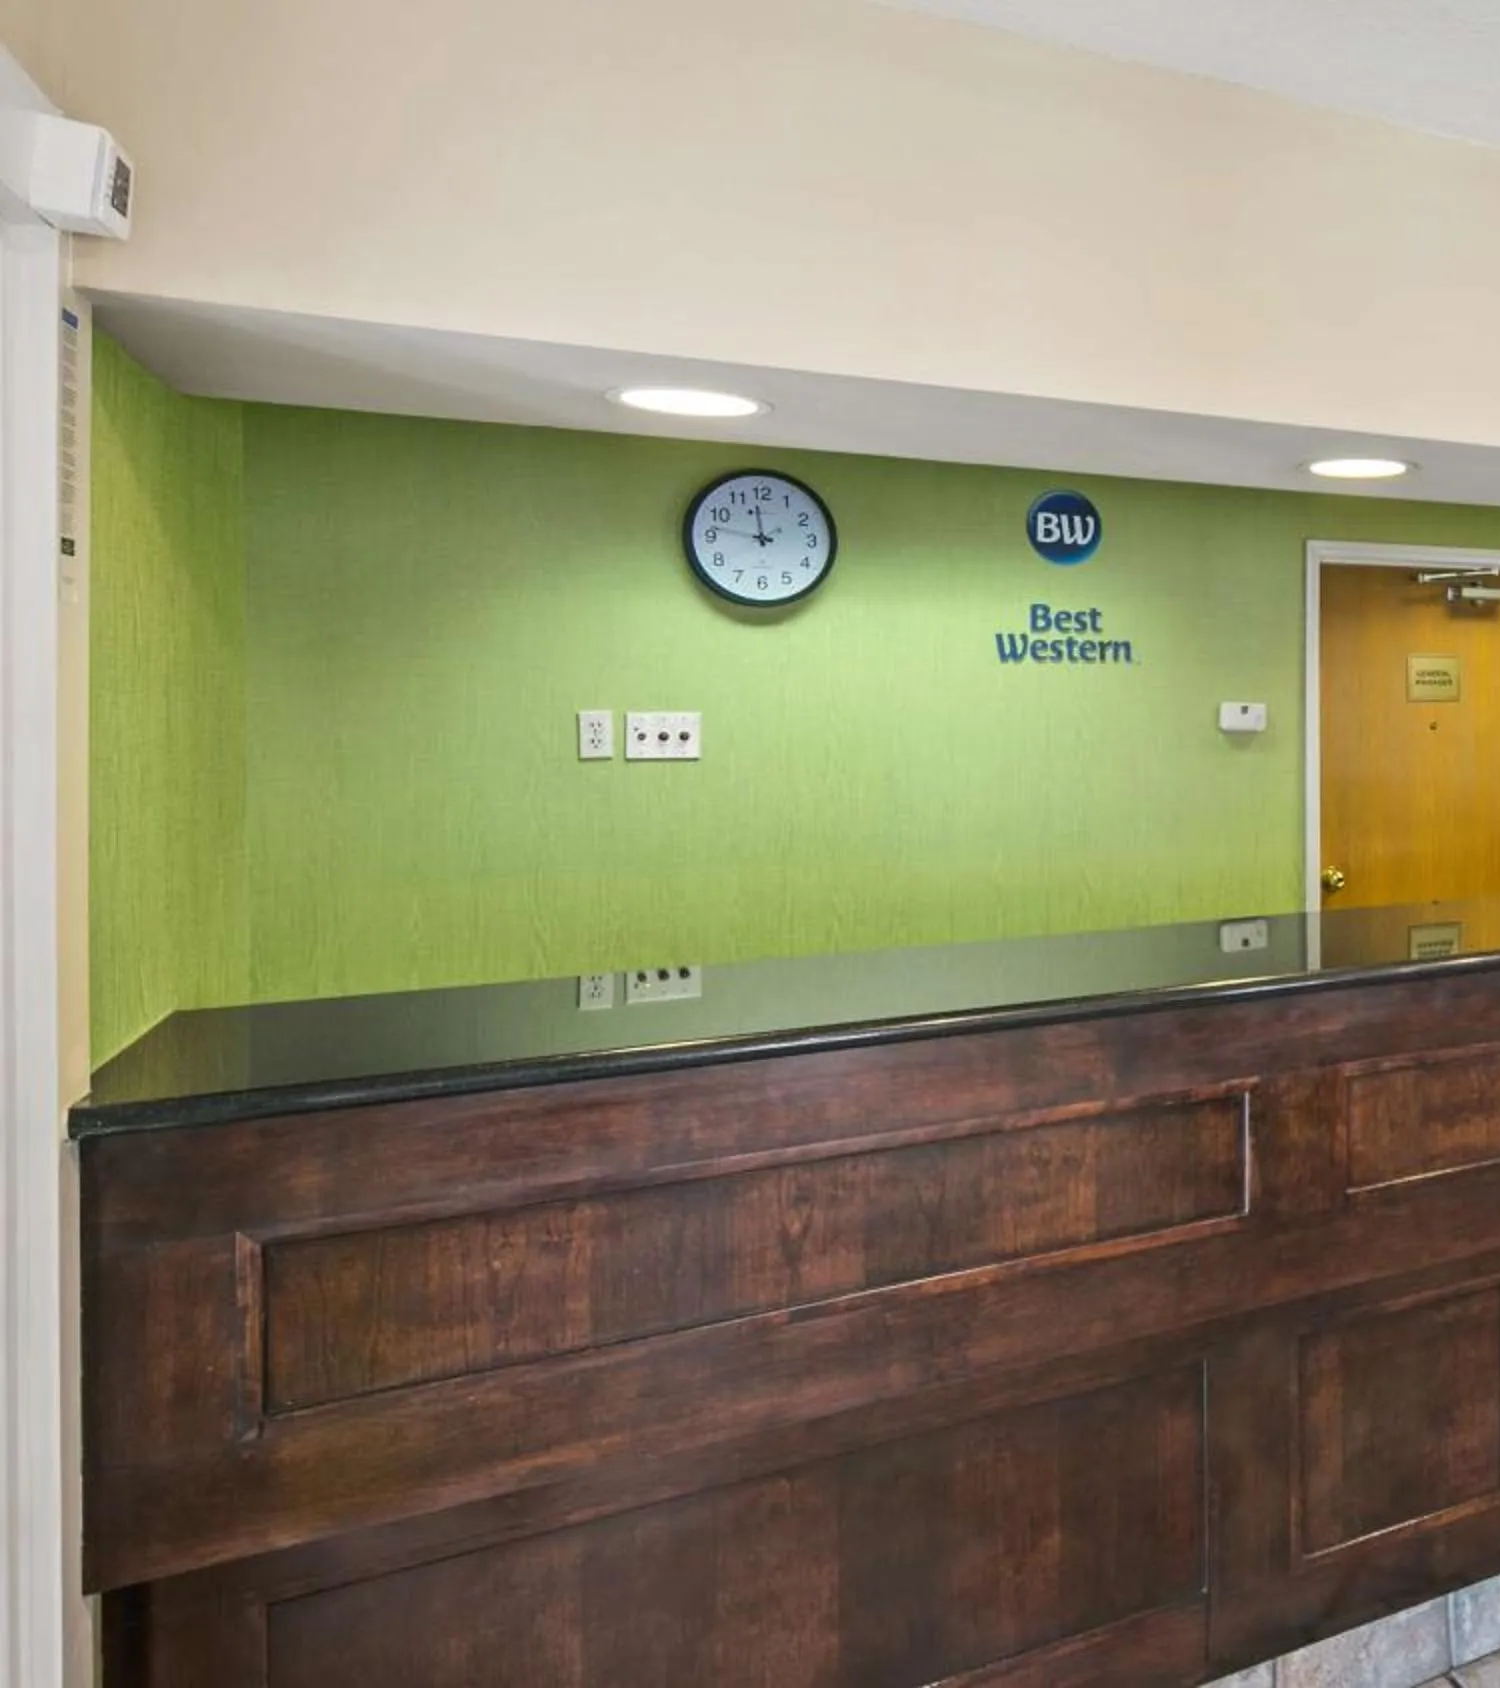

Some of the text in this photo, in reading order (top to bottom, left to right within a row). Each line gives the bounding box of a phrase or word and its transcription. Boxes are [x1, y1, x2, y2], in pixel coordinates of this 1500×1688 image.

[729, 491, 746, 504] 11
[753, 487, 772, 501] 12
[783, 495, 789, 509] 1
[710, 507, 731, 523] 10
[798, 512, 809, 527] 2
[1036, 511, 1095, 545] BW
[704, 529, 717, 544] 9
[807, 533, 817, 549] 3
[713, 552, 725, 567] 8
[800, 556, 810, 570] 4
[733, 569, 744, 583] 7
[757, 576, 769, 590] 6
[781, 571, 793, 585] 5
[1029, 603, 1103, 634] Best
[995, 633, 1133, 664] Western
